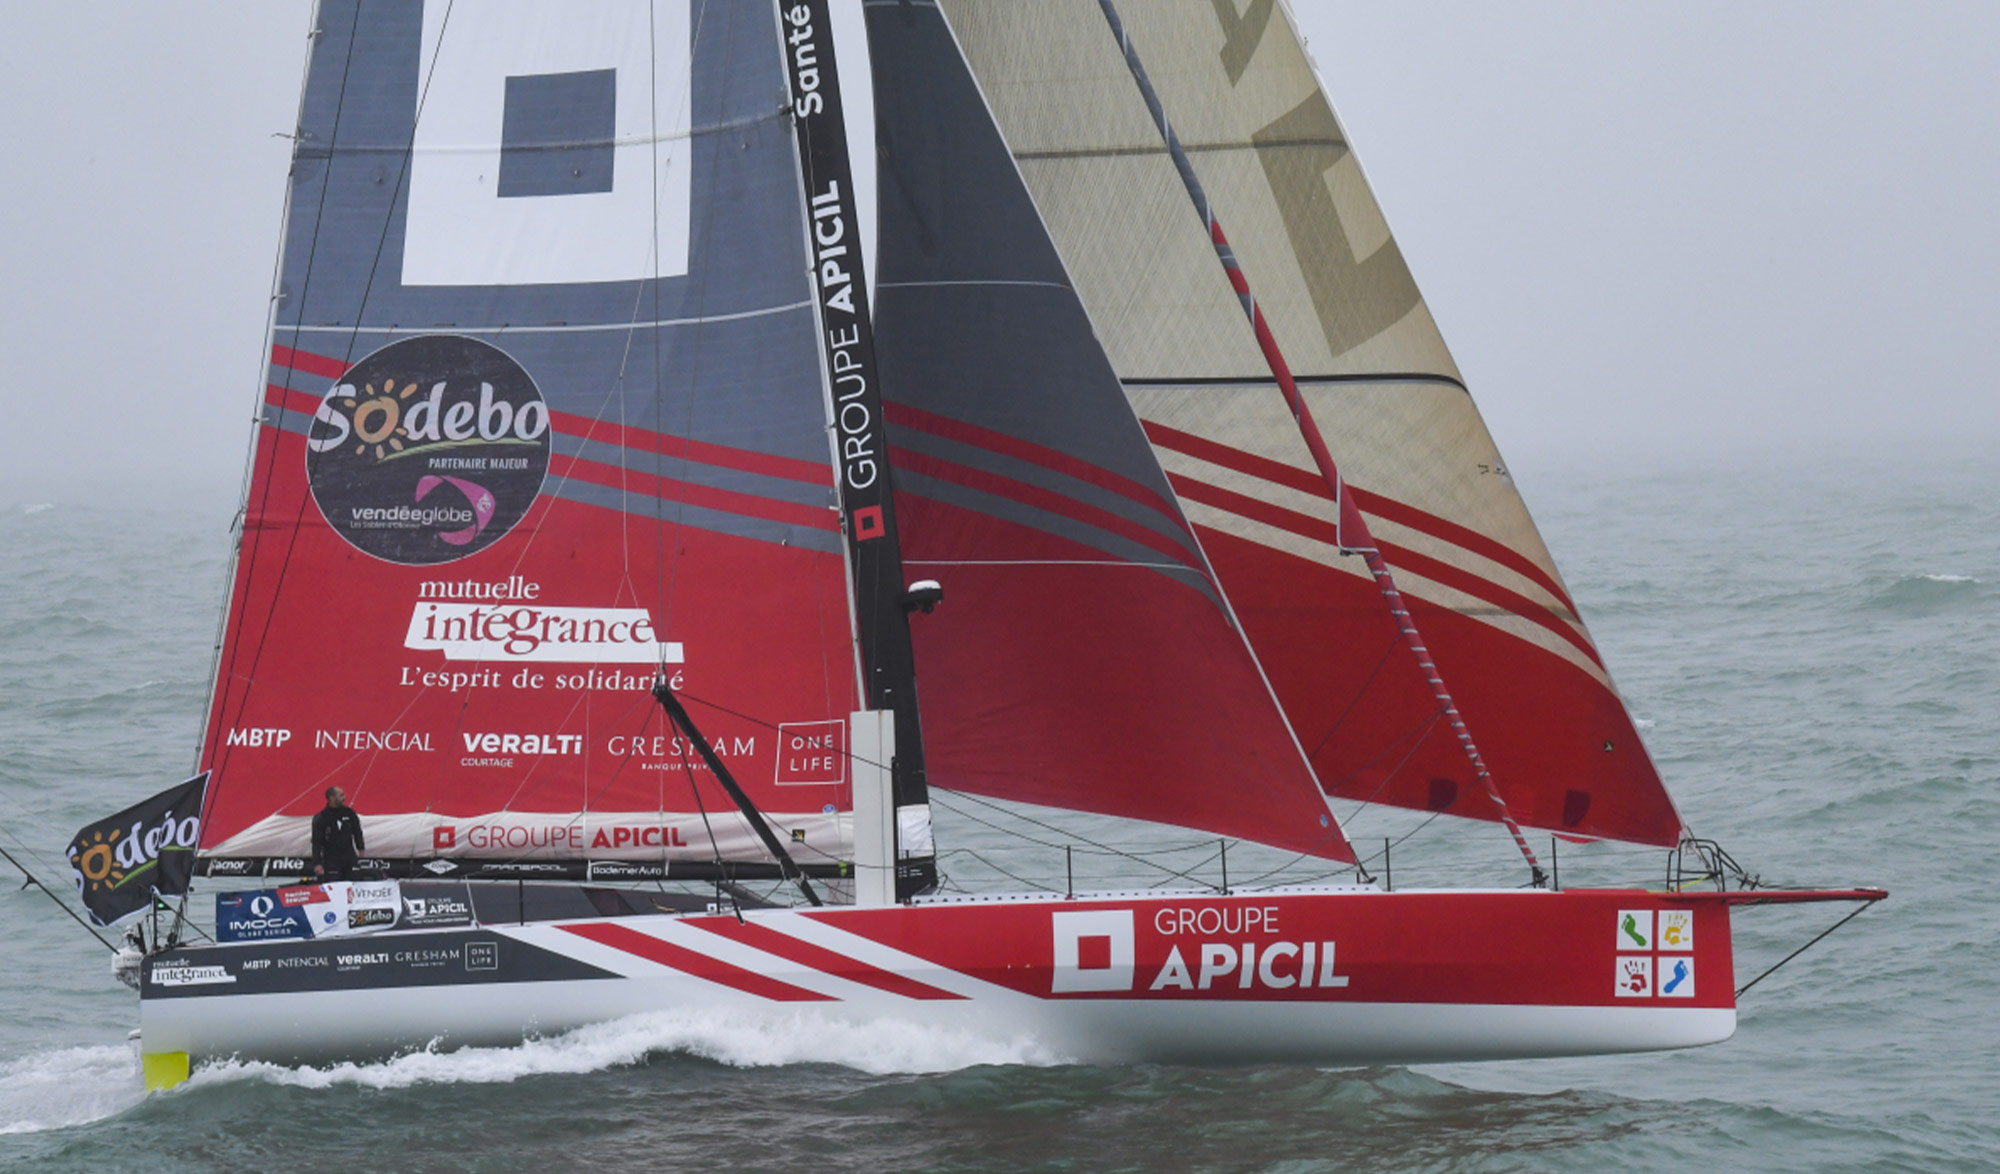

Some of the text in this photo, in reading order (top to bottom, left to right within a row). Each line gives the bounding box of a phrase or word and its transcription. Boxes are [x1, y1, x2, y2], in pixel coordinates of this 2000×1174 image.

[784, 4, 823, 118] Santé
[812, 179, 877, 490] GROUPE APICIL
[309, 381, 550, 453] Sodebo
[429, 458, 529, 470] PARTENAIRE MAJEUR
[418, 575, 541, 600] mutuelle
[423, 604, 653, 655] intégrance
[400, 667, 502, 692] L'esprit
[512, 668, 544, 689] de
[226, 728, 291, 748] MBTP
[315, 729, 435, 751] INTENCIAL
[791, 735, 834, 751] ONE
[461, 757, 514, 768] COURTAGE
[641, 763, 683, 771] BANQUE
[790, 756, 834, 772] LIFE
[467, 825, 688, 849] GROUPE APICIL
[272, 857, 305, 870] nke
[428, 902, 469, 914] APICIL
[229, 917, 298, 931] IMOCA
[1154, 907, 1280, 935] GROUPE
[394, 949, 460, 963] GRESHAM
[471, 948, 492, 956] ONE
[242, 960, 271, 970] MBTP
[277, 957, 329, 969] INTENCIAL
[471, 957, 492, 965] LIFE
[1149, 941, 1350, 991] APICIL
